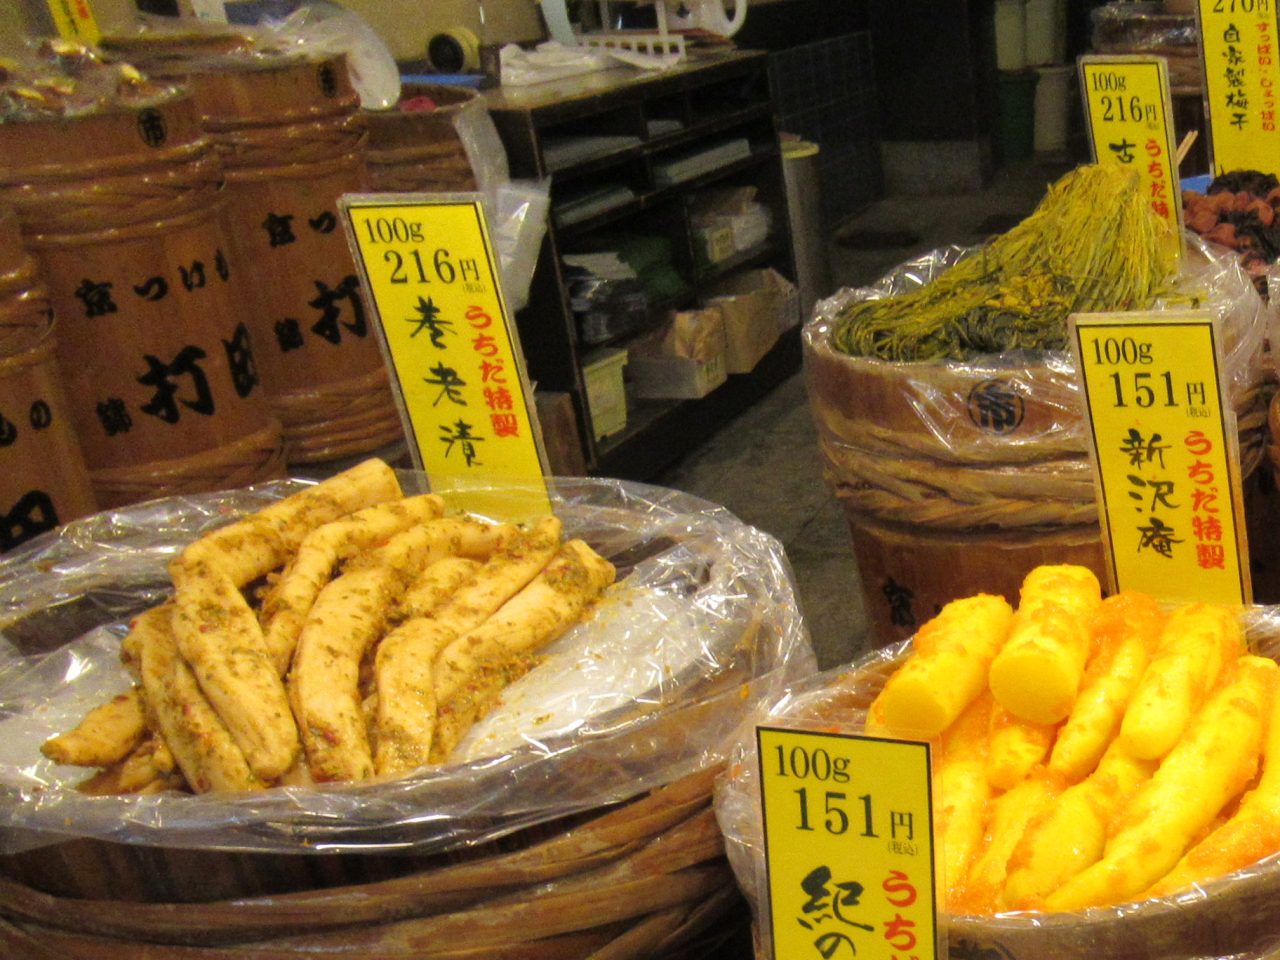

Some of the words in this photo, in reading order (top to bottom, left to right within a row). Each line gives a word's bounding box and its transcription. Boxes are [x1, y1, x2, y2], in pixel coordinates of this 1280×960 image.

[1092, 72, 1126, 92] 100g
[1101, 96, 1157, 122] 216円
[364, 217, 425, 244] 100g
[384, 249, 480, 284] 216円
[1091, 337, 1153, 365] 100g
[465, 305, 519, 437] うちだ特製
[1109, 371, 1206, 408] 151円
[1119, 428, 1185, 559] 新沢庵
[1184, 430, 1225, 570] うちだ特製
[775, 745, 851, 783] 100g
[794, 788, 914, 840] 151円
